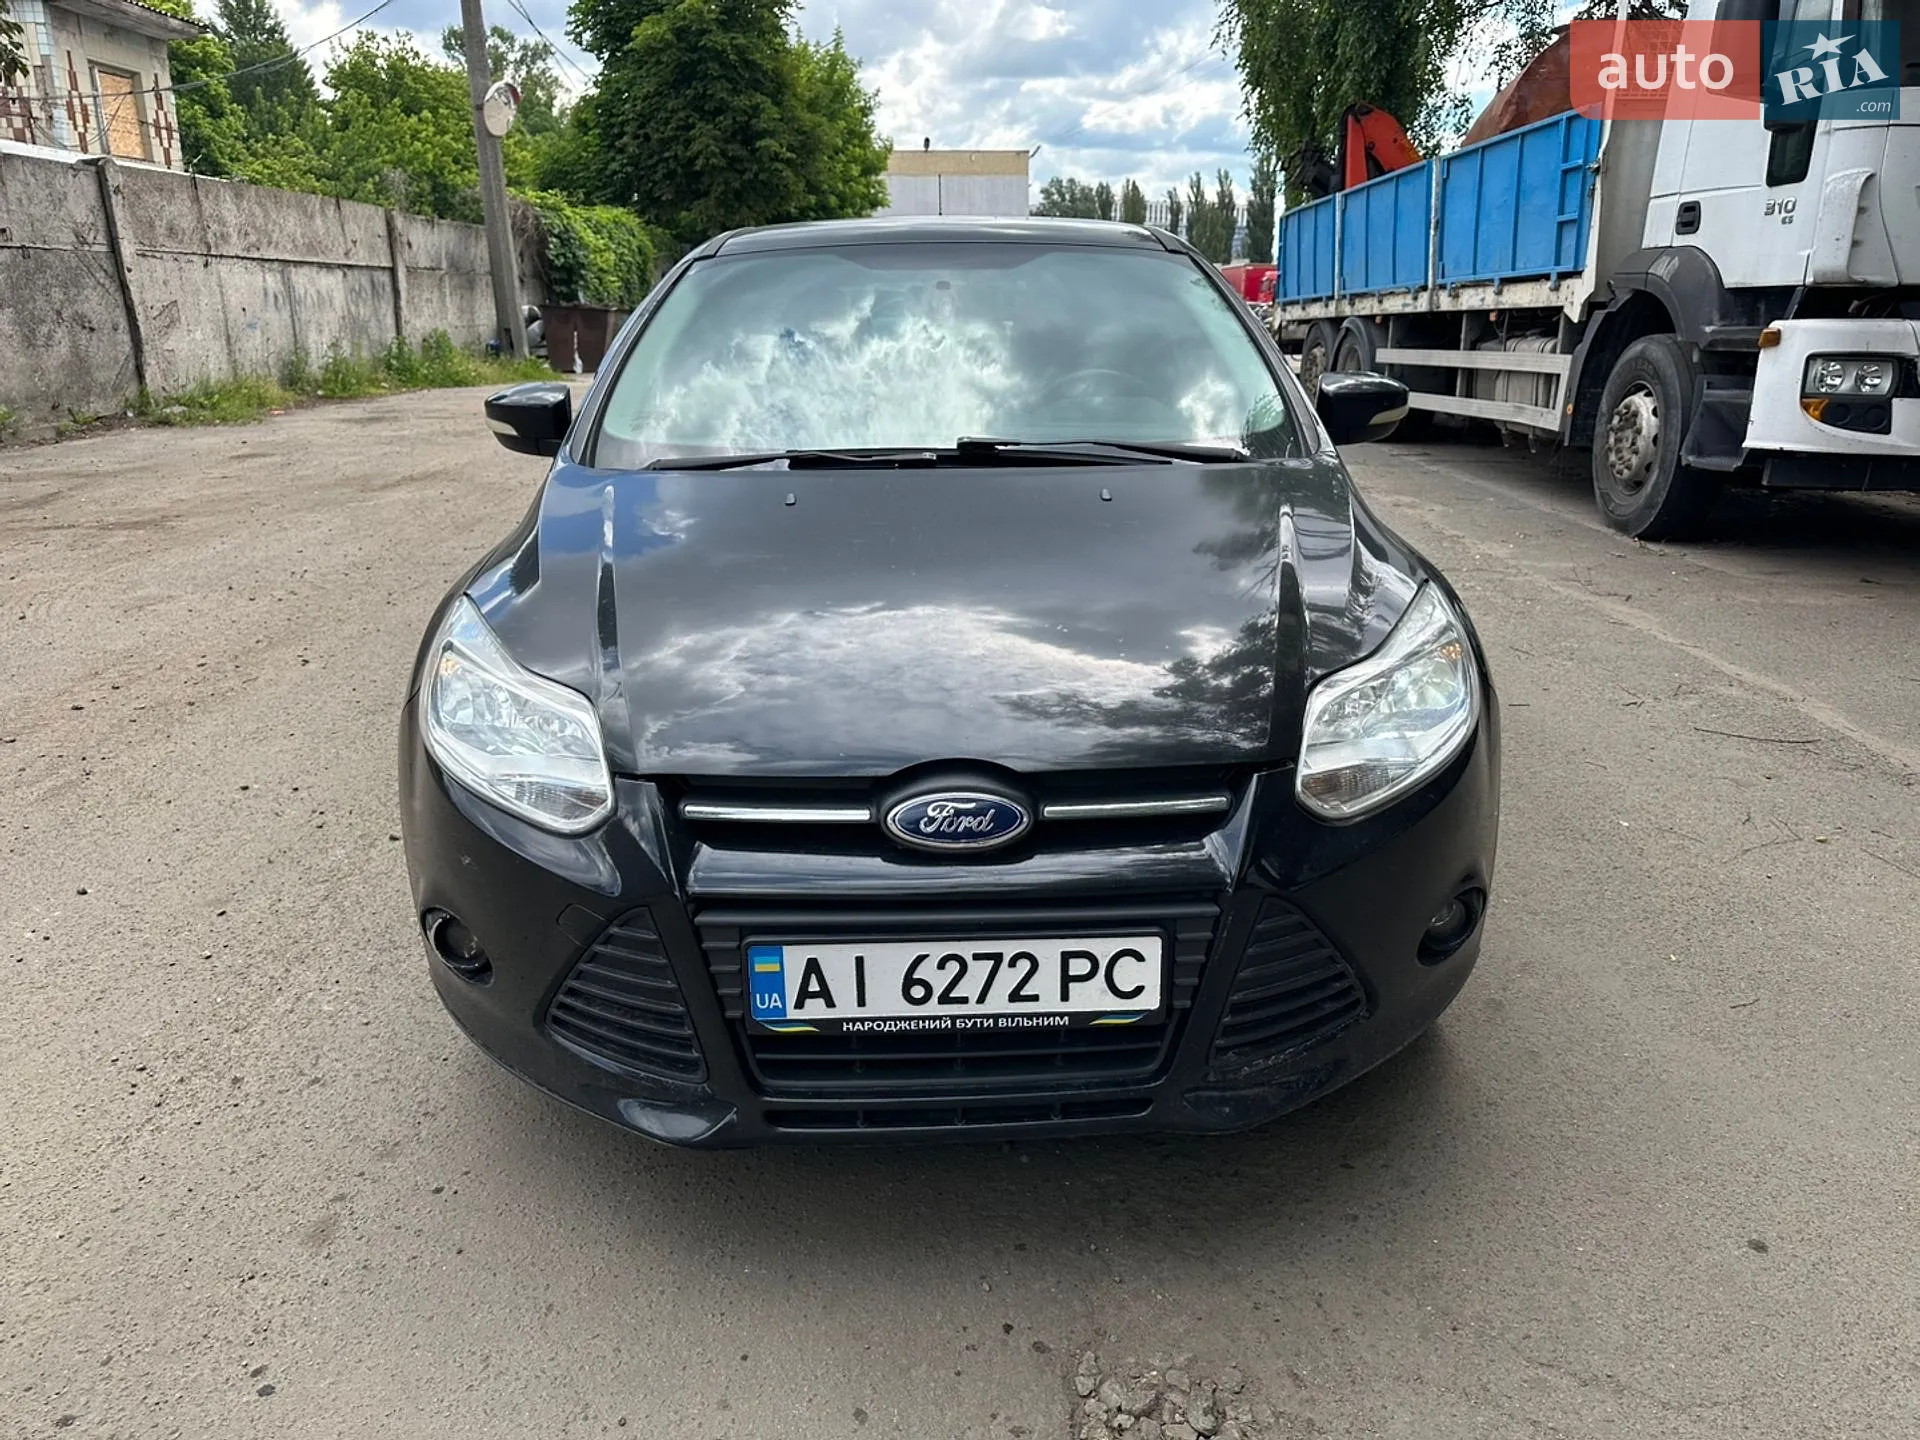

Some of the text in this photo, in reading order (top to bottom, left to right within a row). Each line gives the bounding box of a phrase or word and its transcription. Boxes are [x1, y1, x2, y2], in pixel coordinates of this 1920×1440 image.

[1764, 198, 1798, 216] 310
[919, 801, 996, 833] Ford
[793, 948, 1146, 1010] AI 6272 PC
[756, 993, 783, 1009] UA
[842, 1016, 1070, 1032] НАРОДЖЕНИЙ БУТИ ВІЛЬНИМ
